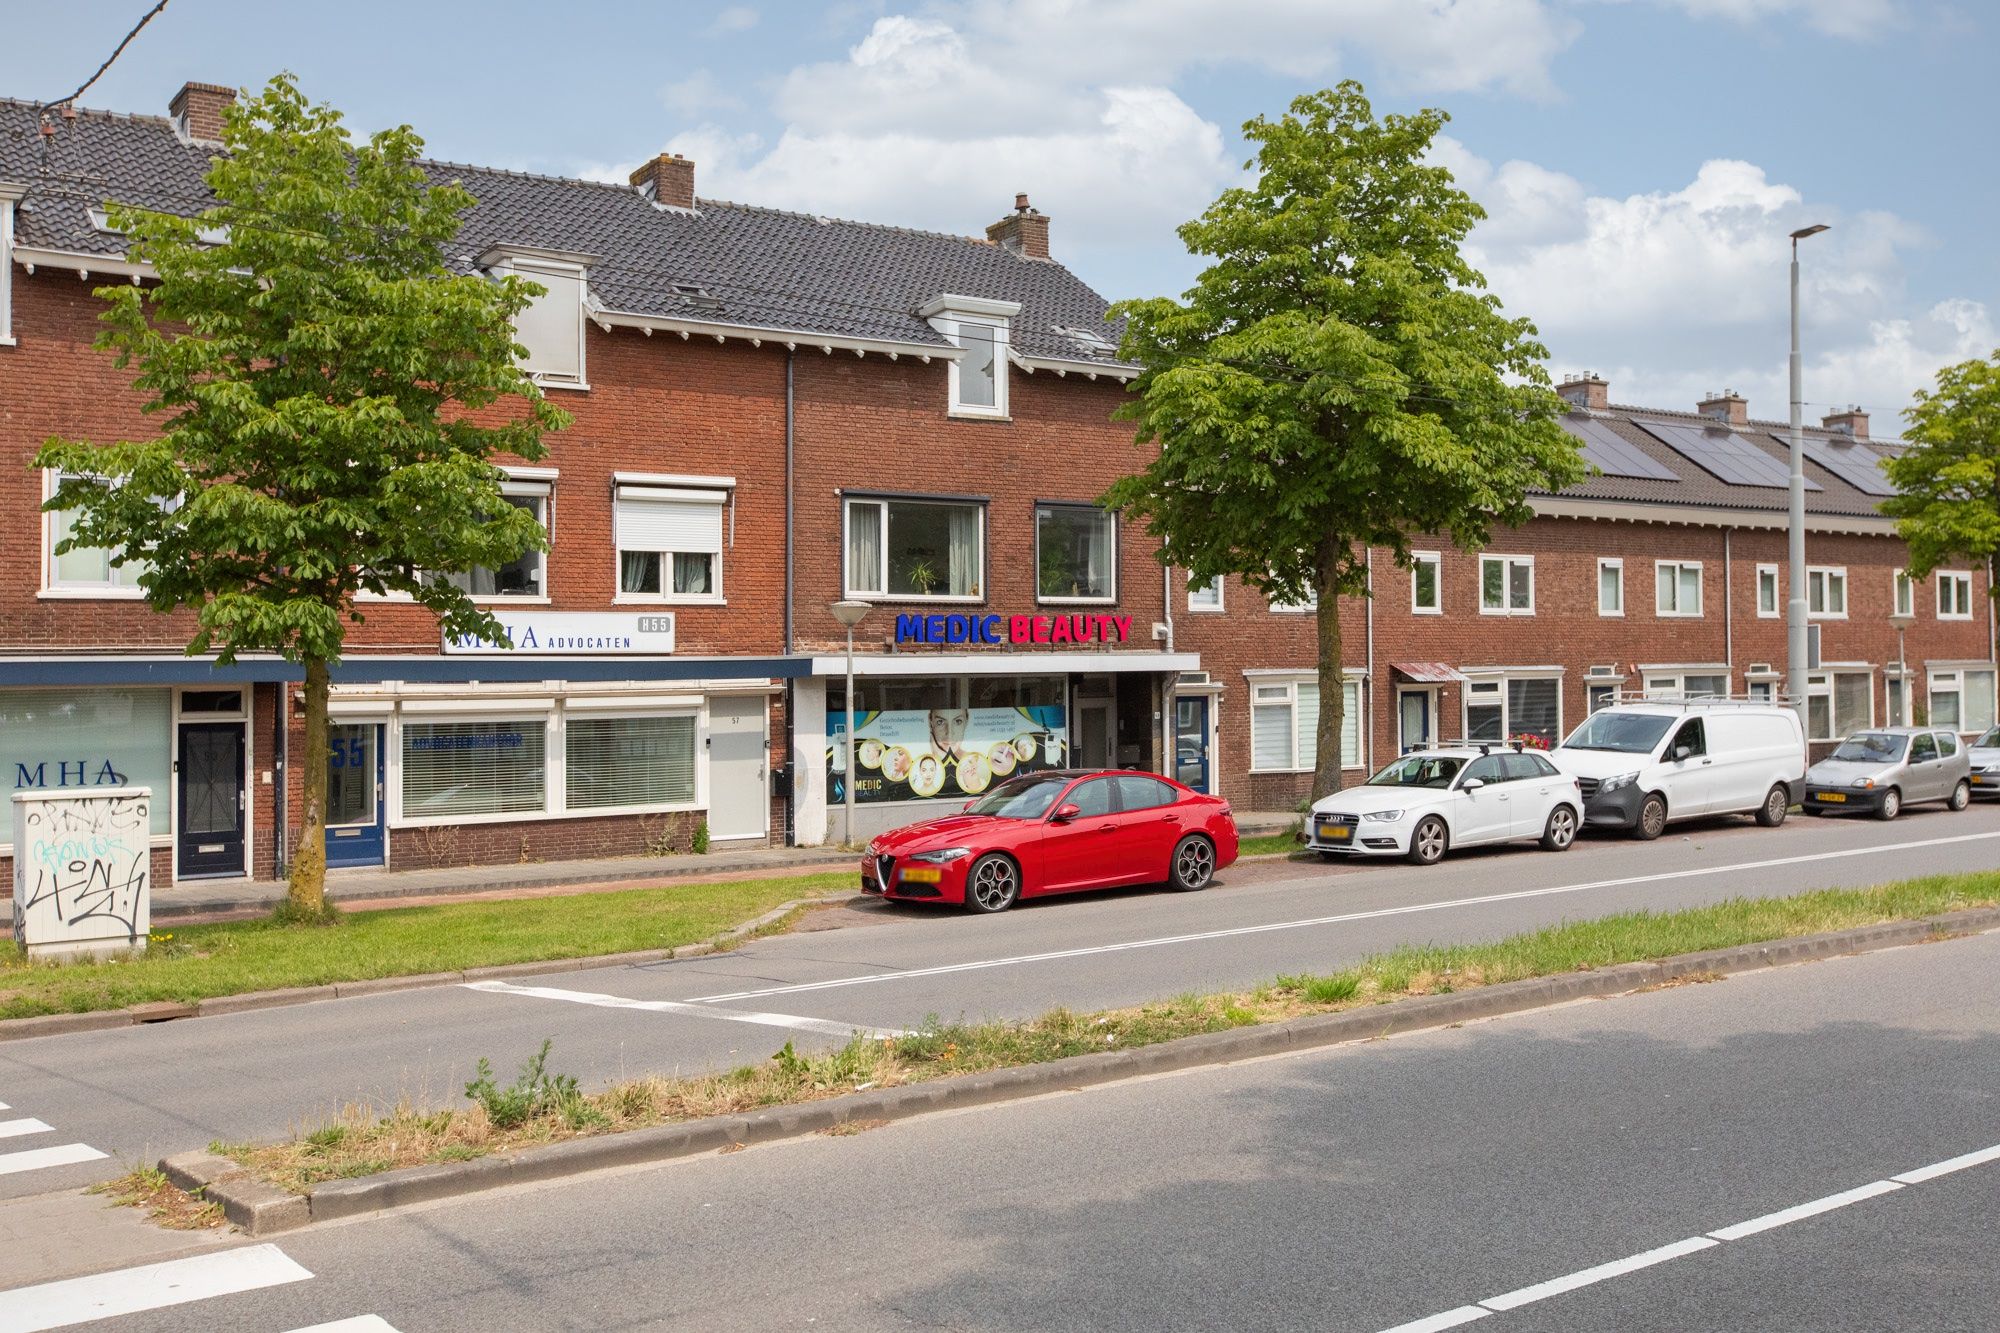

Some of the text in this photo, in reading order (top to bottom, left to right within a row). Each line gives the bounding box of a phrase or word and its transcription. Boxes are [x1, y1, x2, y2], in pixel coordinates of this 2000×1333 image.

[642, 618, 667, 631] H55
[895, 613, 1133, 643] MEDIC BEAUTY
[548, 637, 631, 649] ADVOCATEN
[331, 737, 365, 768] 55
[14, 759, 120, 788] MHA
[855, 779, 882, 790] MEDIC
